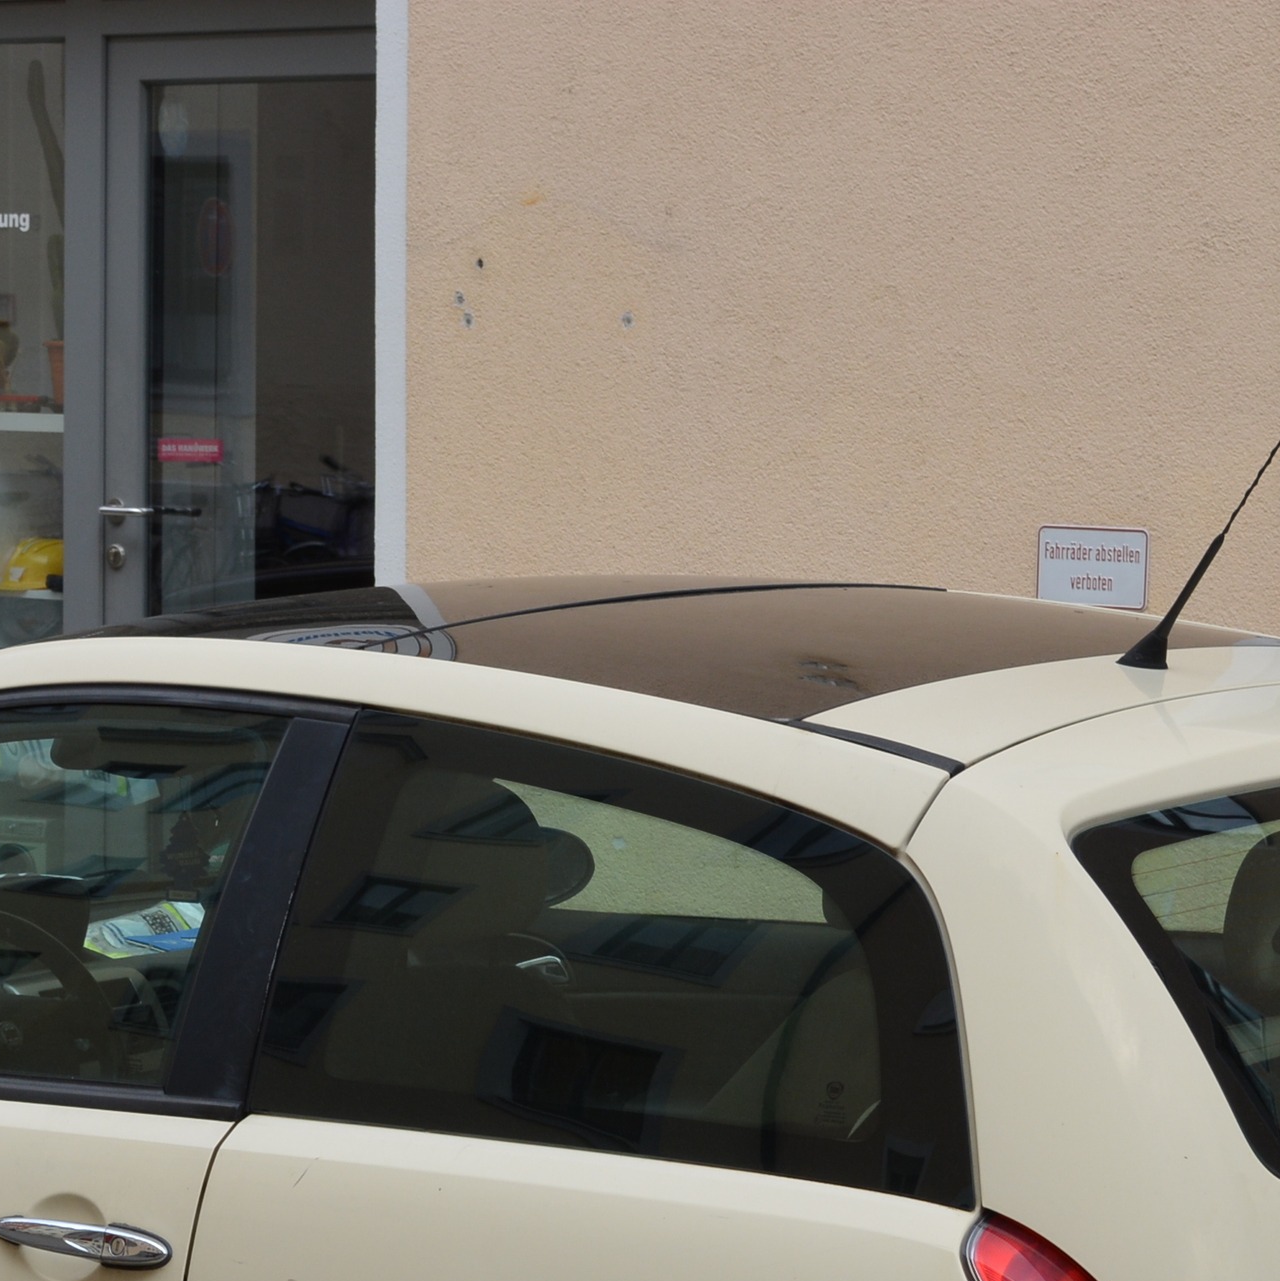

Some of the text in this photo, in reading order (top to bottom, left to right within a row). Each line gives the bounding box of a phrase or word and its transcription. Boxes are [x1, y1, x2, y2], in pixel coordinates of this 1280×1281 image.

[1044, 541, 1140, 564] Fahrräder abstellen
[1070, 573, 1113, 592] verboten
